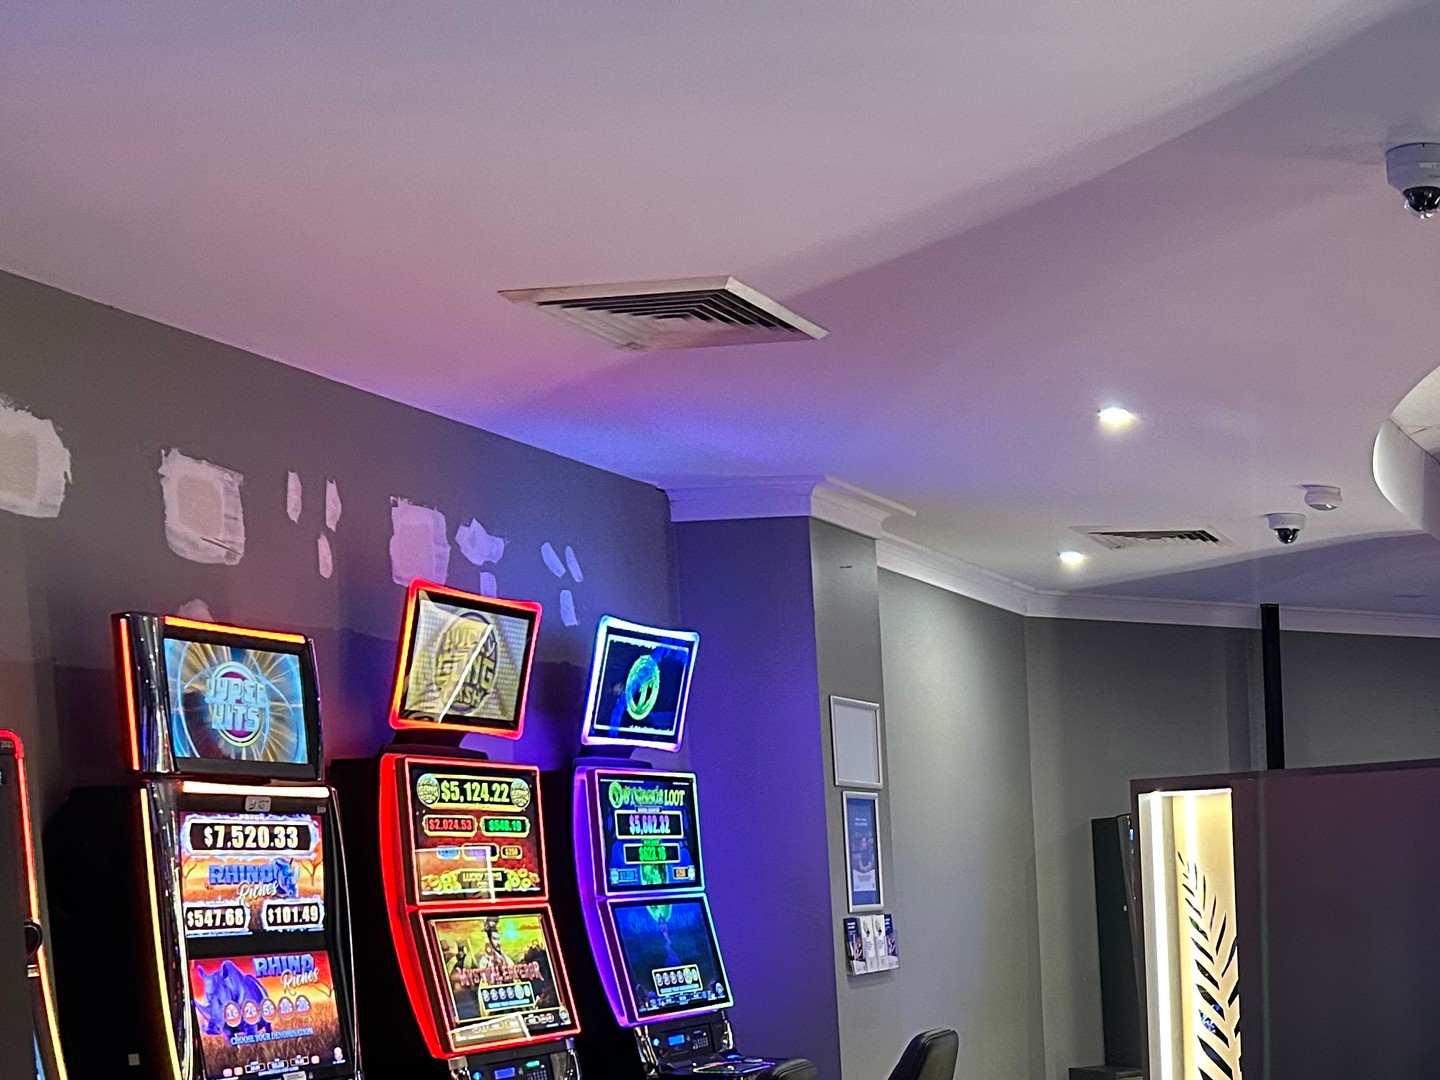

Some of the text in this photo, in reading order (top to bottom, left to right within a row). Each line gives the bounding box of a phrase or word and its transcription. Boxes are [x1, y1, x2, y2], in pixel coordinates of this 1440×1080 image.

[211, 703, 261, 733] HITS
[441, 780, 511, 802] $5,124.22
[664, 789, 686, 806] LOOT
[208, 863, 274, 886] RHINO
[236, 880, 279, 906] Riches
[187, 907, 245, 928] $547.68
[267, 905, 319, 928] $101.49
[252, 953, 315, 978] RHINO
[280, 967, 321, 996] Riches
[230, 1034, 254, 1045] CHOOSE
[254, 1032, 271, 1043] YOUR
